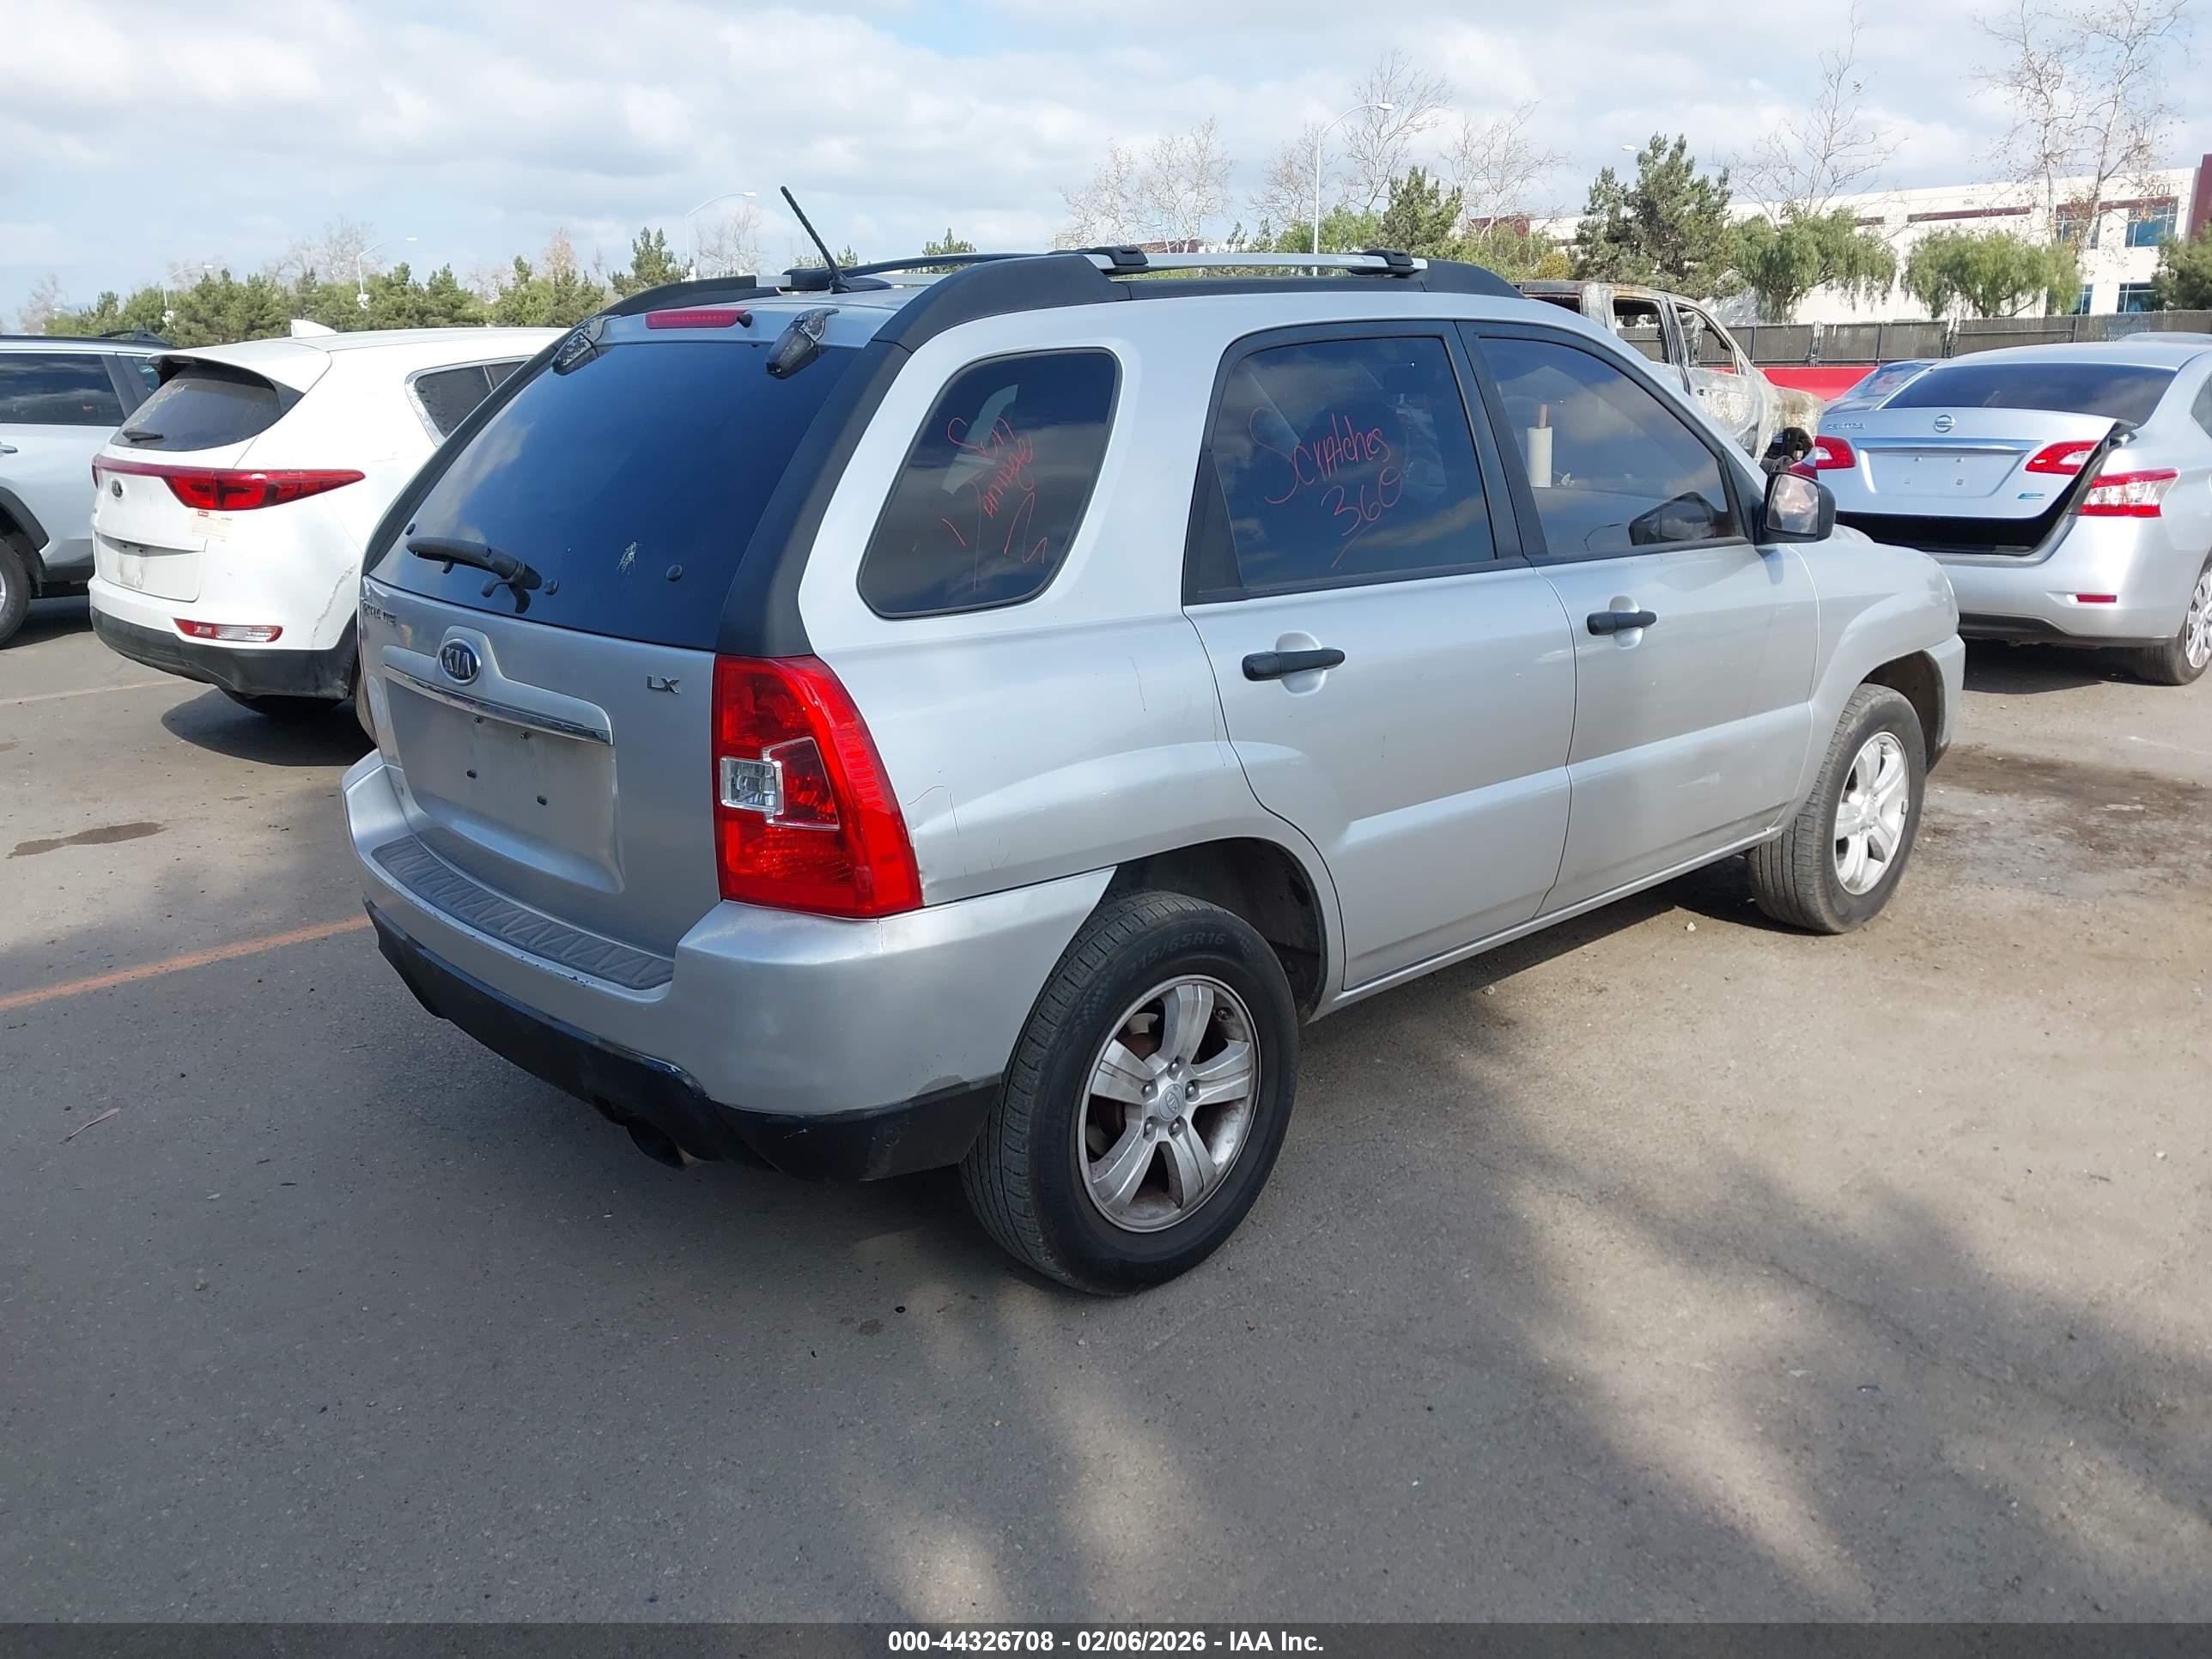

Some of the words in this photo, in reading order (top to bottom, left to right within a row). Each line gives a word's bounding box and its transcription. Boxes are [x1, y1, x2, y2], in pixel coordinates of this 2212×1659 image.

[2138, 183, 2171, 198] 2201
[1321, 466, 1402, 537] 360
[445, 647, 471, 677] KIA
[647, 676, 679, 694] LX
